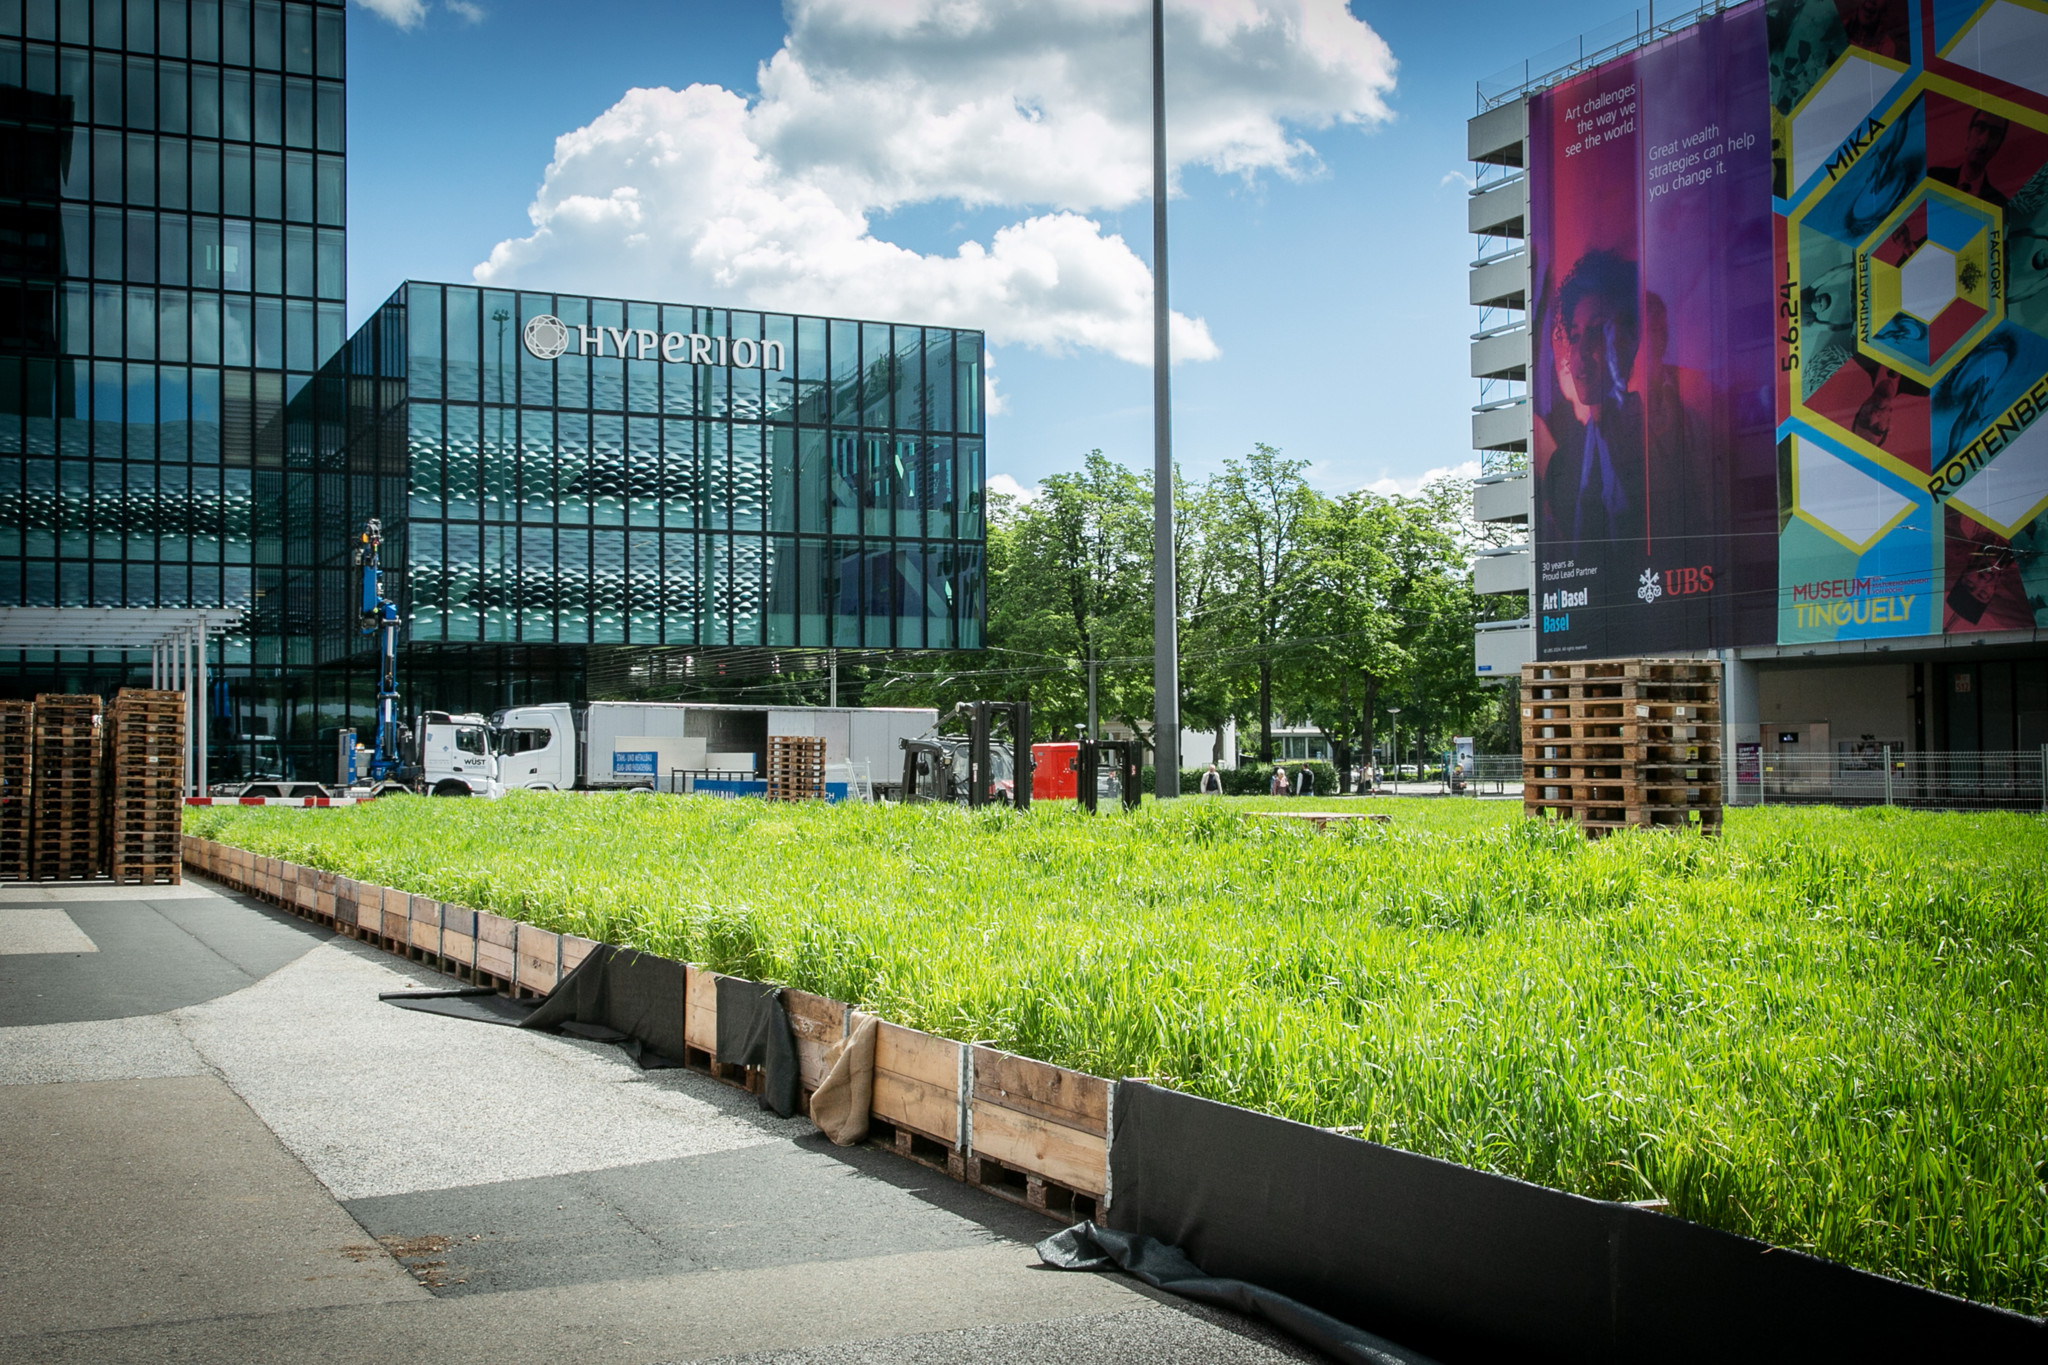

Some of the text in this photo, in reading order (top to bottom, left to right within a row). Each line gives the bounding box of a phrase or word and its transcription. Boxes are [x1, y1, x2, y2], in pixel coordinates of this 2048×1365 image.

[1565, 83, 1636, 122] Art challenges
[1577, 102, 1636, 135] the way we
[1565, 120, 1637, 158] see the world.
[1649, 124, 1720, 161] Great wealth
[1649, 132, 1755, 180] strategies can help
[1824, 117, 1886, 182] MIKA
[1648, 161, 1727, 202] you change it.
[1990, 230, 2002, 300] FACTORY
[1859, 252, 1869, 344] ANTIMATTER
[1927, 376, 2048, 504] ROTTENBE
[1542, 560, 1574, 572] 30 years as
[1542, 567, 1598, 582] Proud Lead Partner
[1664, 565, 1715, 596] UBS
[1793, 578, 1871, 601] MUSEUM
[1543, 613, 1570, 633] Basel
[1793, 594, 1916, 629] TINGUELY
[463, 757, 486, 766] WÜST
